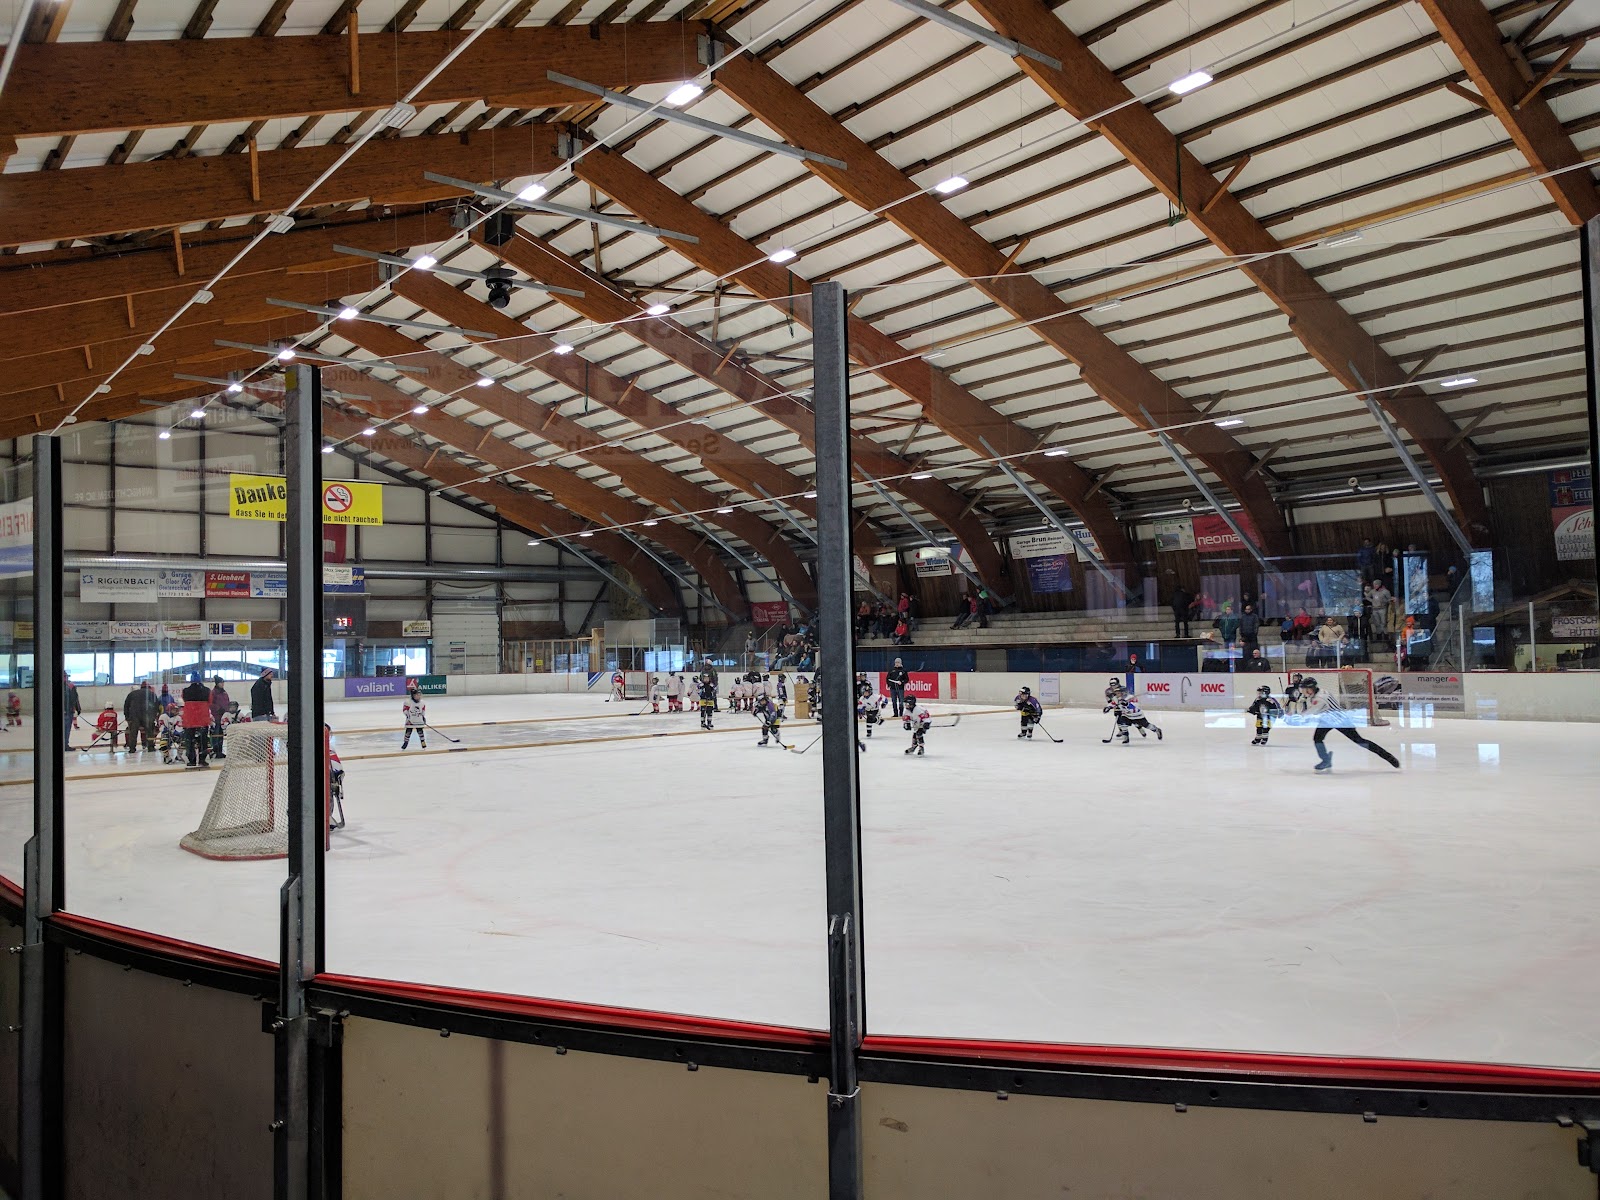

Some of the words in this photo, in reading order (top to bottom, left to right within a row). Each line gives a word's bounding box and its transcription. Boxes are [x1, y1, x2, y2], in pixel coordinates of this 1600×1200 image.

[235, 508, 252, 518] dass
[254, 509, 266, 519] Sie
[268, 510, 275, 519] in
[333, 514, 351, 523] nicht
[352, 515, 381, 524] rauchen.
[218, 573, 246, 581] Lienhard
[1417, 676, 1449, 684] manger
[356, 681, 395, 693] valiant
[1147, 683, 1170, 692] KWC
[1200, 683, 1225, 693] KWC
[102, 721, 114, 729] 17
